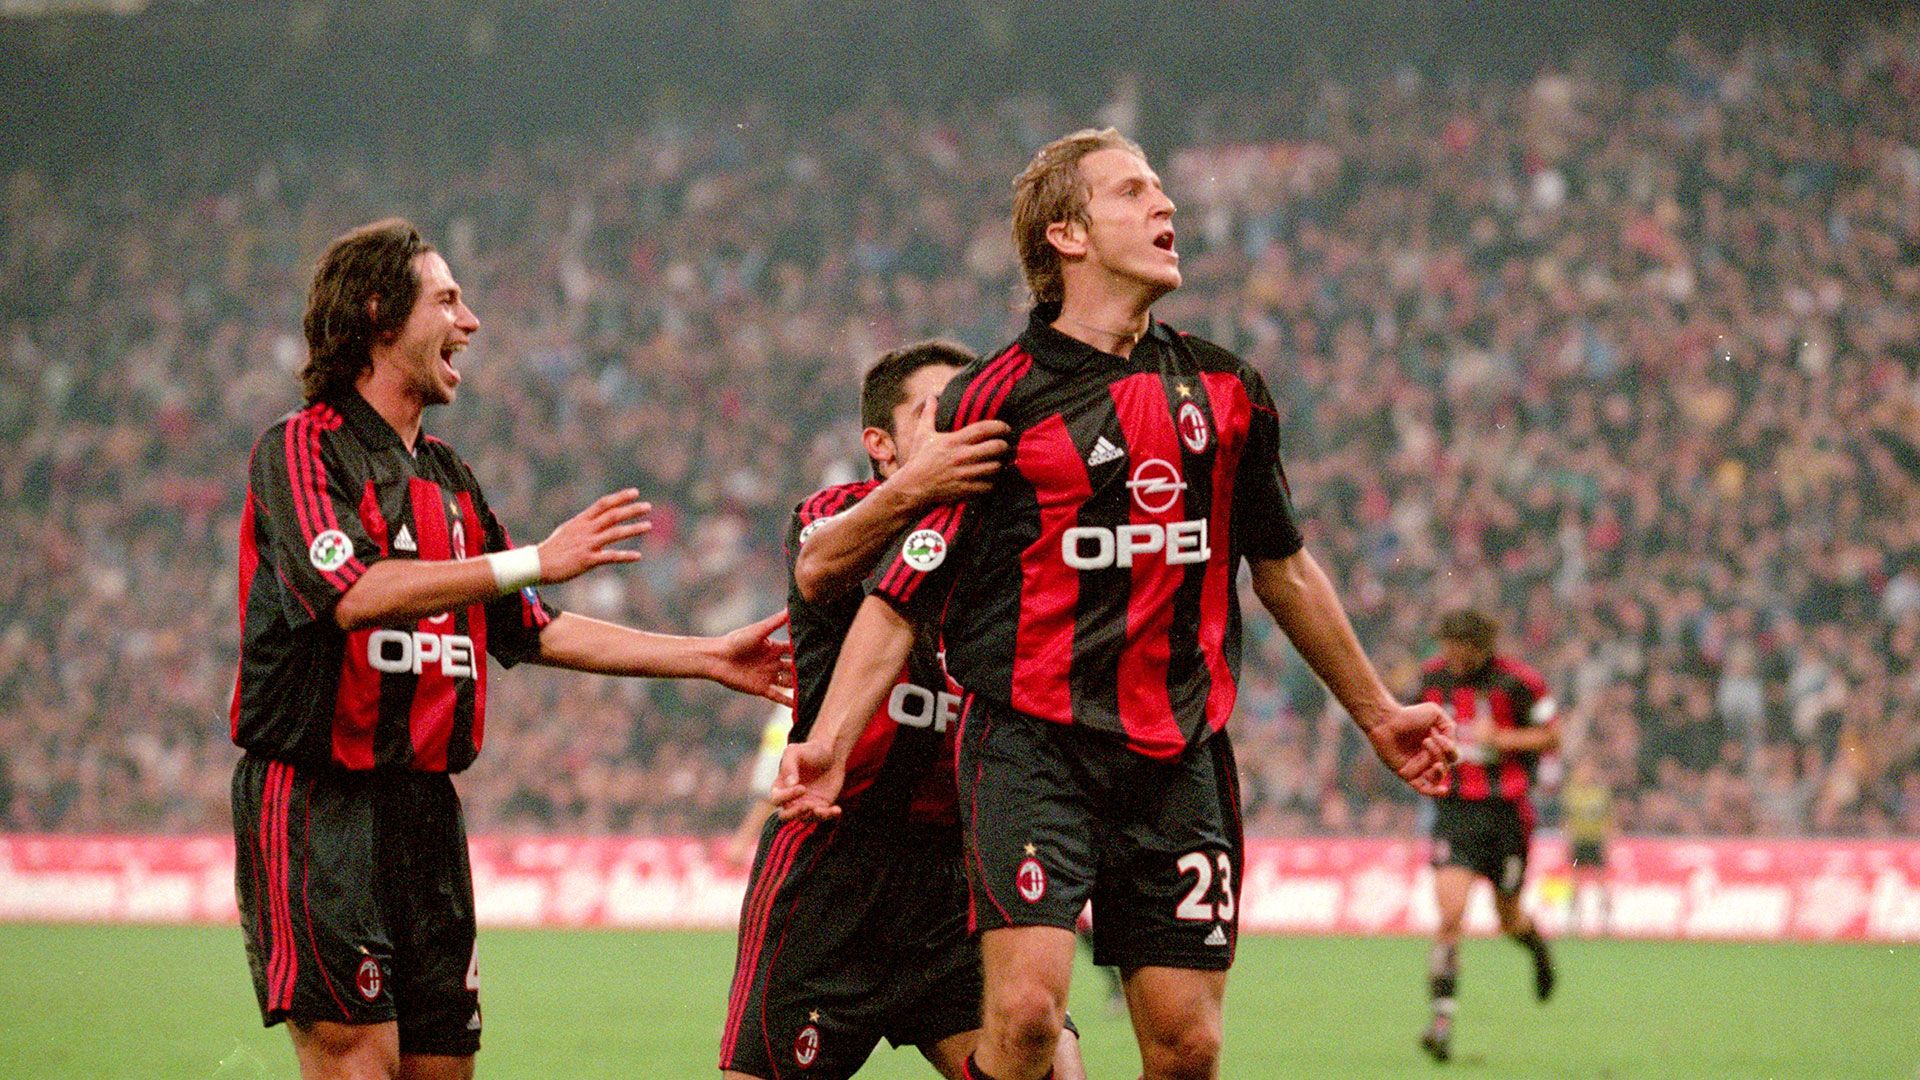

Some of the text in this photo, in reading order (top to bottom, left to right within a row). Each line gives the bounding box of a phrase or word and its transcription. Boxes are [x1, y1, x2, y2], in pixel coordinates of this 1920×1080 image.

[1061, 517, 1211, 570] OPEL
[887, 682, 963, 733] OP
[1175, 851, 1236, 922] 23
